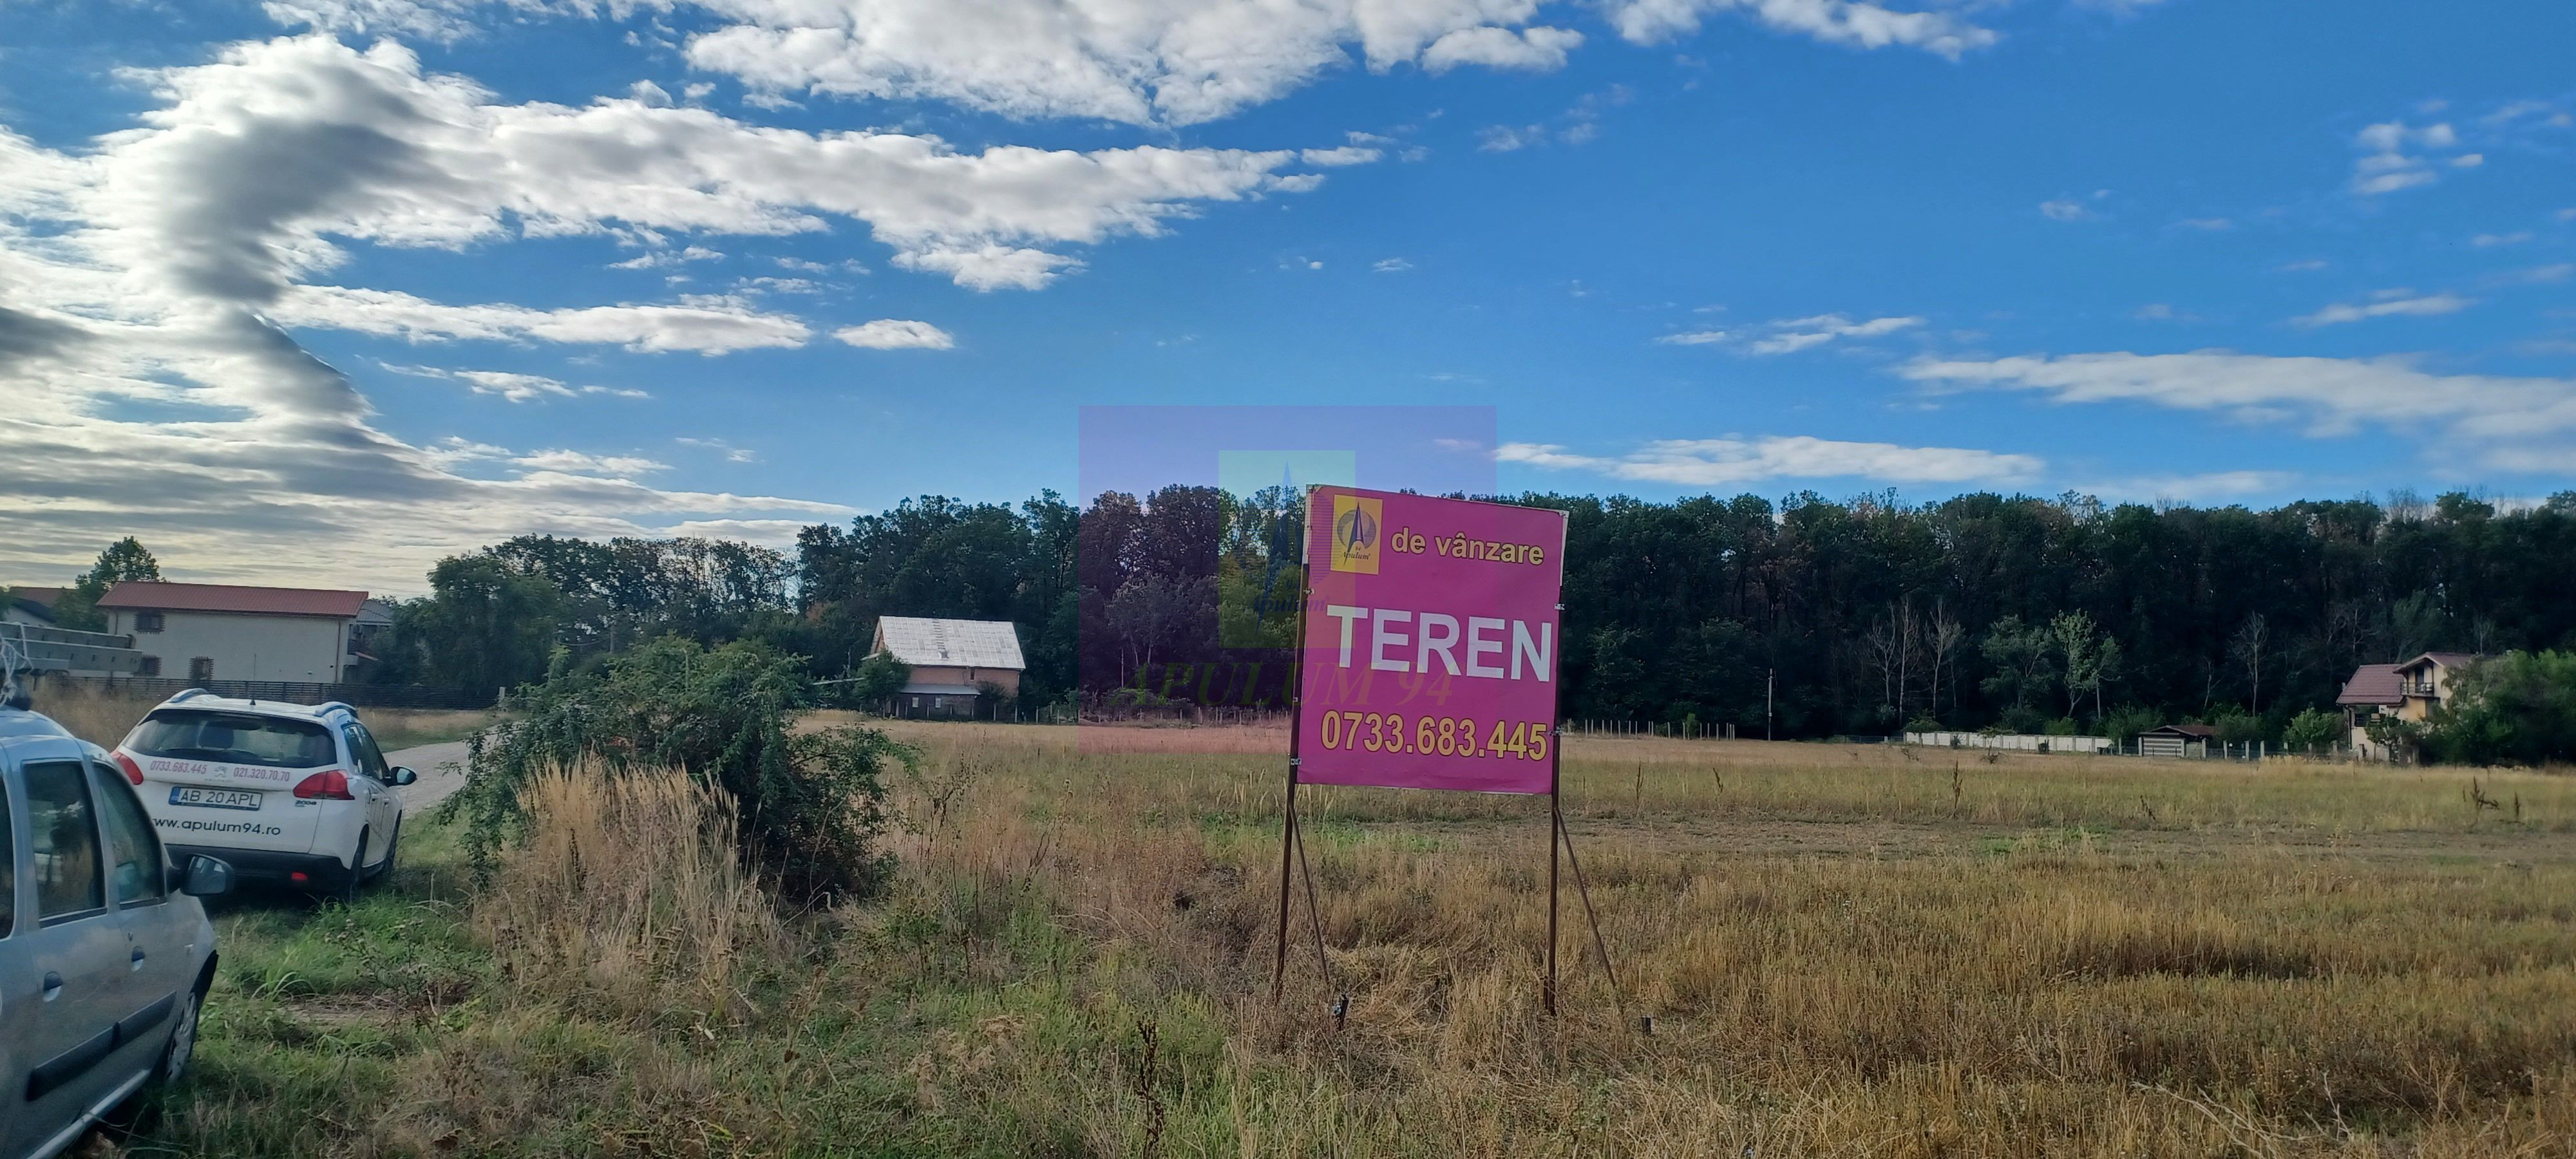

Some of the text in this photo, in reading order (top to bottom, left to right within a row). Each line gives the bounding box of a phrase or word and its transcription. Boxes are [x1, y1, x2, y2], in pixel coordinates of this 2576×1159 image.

[1392, 527, 1545, 566] de vânzare
[1340, 551, 1369, 560] Apulum
[1327, 604, 1552, 683] TEREN
[1321, 709, 1548, 761] 0733.683.445
[149, 760, 207, 775] 0733.683.445
[233, 767, 290, 782] 021.320.70.70
[180, 789, 258, 807] AB 20 APL
[153, 818, 281, 835] ww.apulum94.ro
